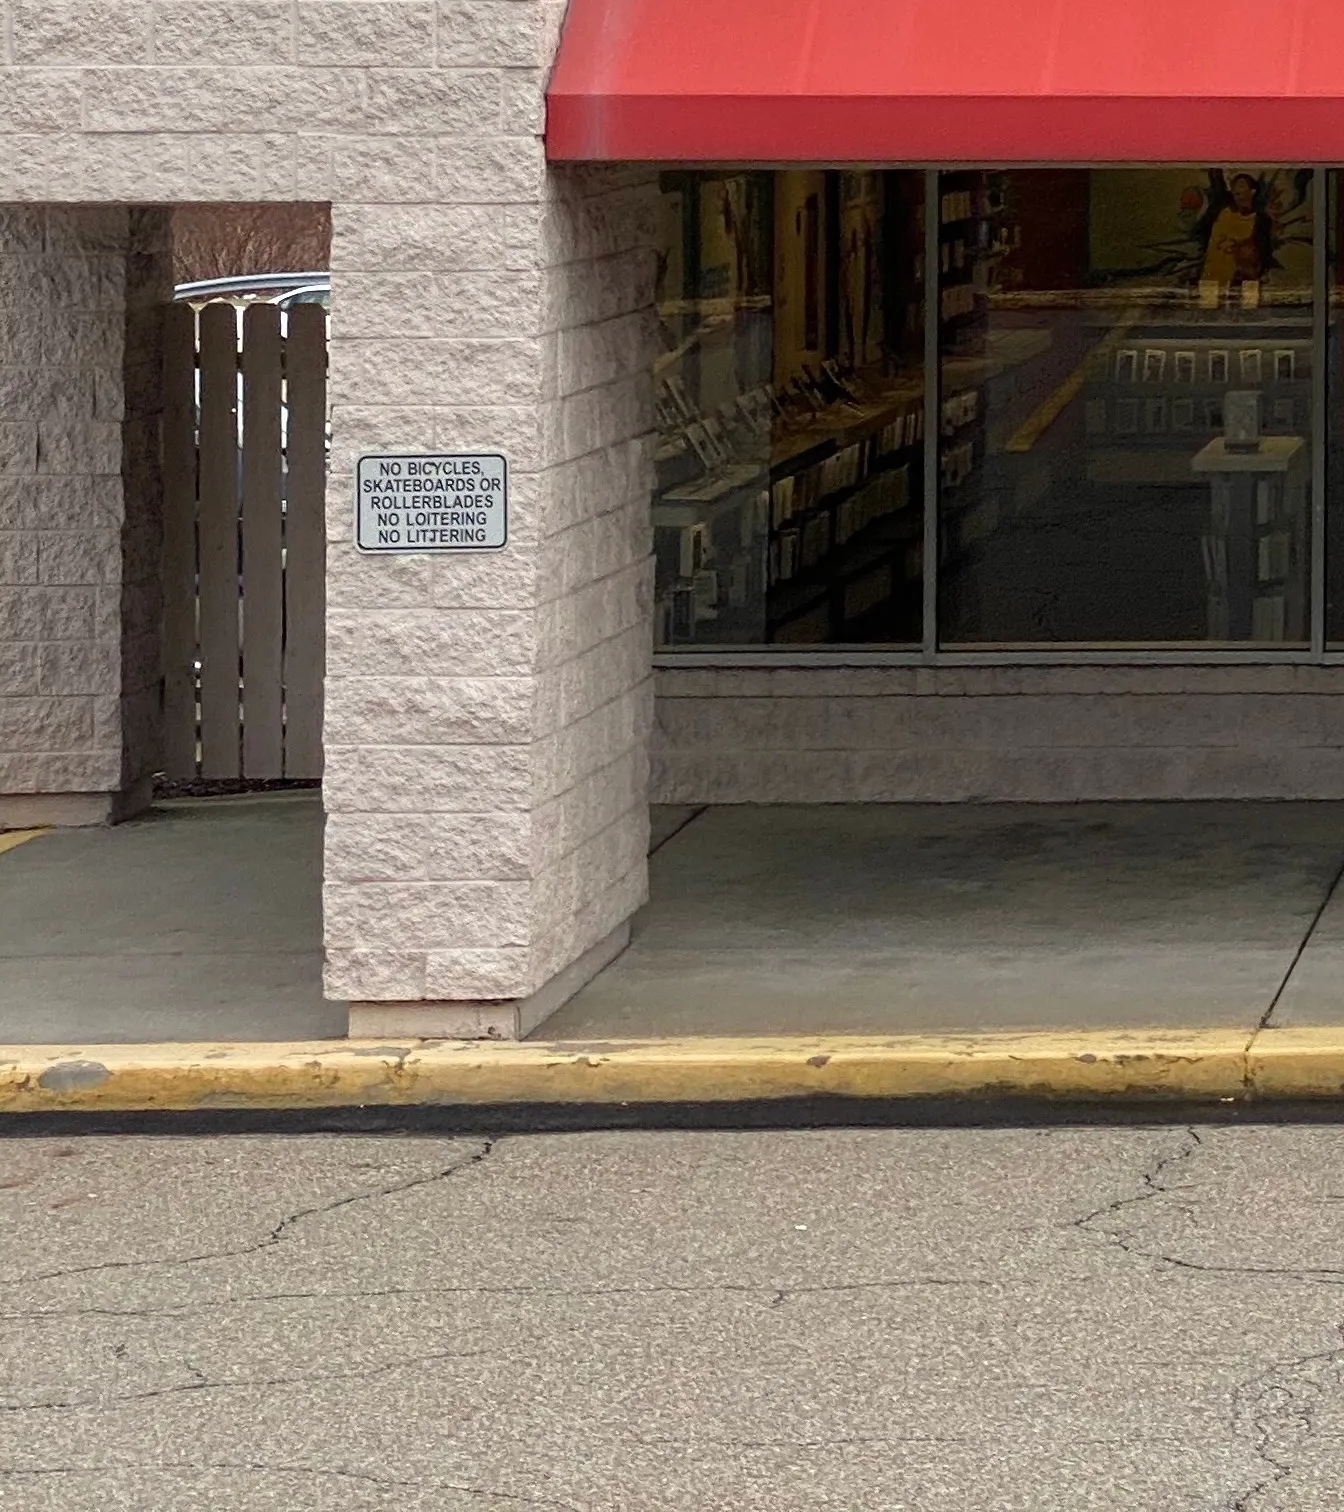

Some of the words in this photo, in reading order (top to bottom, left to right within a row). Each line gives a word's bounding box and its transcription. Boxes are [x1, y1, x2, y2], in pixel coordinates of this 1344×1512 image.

[380, 462, 401, 476] NO
[408, 461, 485, 477] BICYCLES,
[363, 478, 477, 493] SKATEBOARDS
[480, 478, 501, 492] OR
[371, 495, 494, 509] ROLLERBLADES
[377, 513, 399, 526] NO
[406, 512, 487, 526] LOITERING
[378, 530, 400, 543] NO
[407, 529, 486, 543] LITTERING
